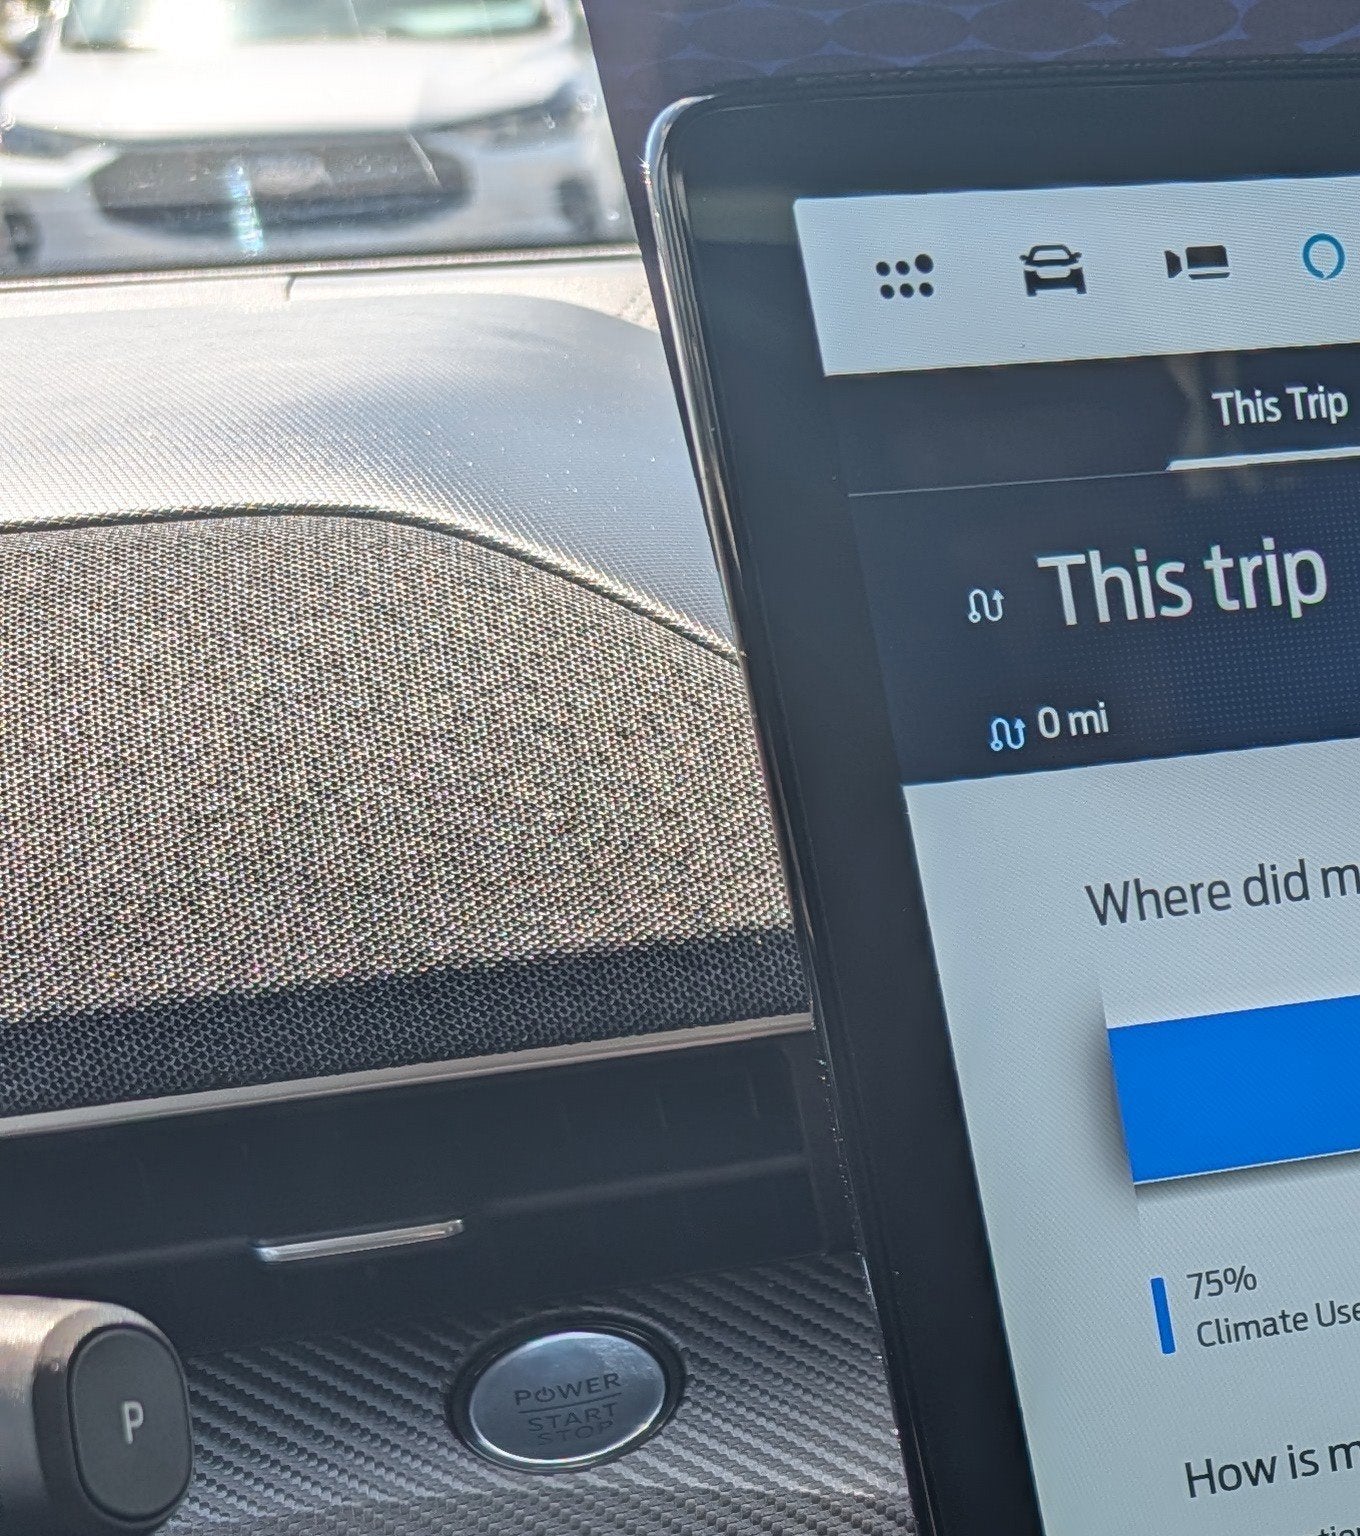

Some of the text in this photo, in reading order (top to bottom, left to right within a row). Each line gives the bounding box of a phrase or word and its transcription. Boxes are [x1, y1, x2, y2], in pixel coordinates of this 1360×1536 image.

[1211, 385, 1347, 425] This Trip
[1037, 538, 1327, 625] This trip
[1038, 702, 1108, 738] 0 mi
[1085, 879, 1230, 925] Where
[1243, 859, 1309, 906] did
[1187, 1266, 1257, 1299] 75%
[1197, 1310, 1308, 1347] Climate
[514, 1373, 621, 1406] POWER
[121, 1400, 145, 1445] P
[528, 1402, 618, 1432] START
[1185, 1457, 1276, 1497] How
[1286, 1445, 1319, 1479] is
